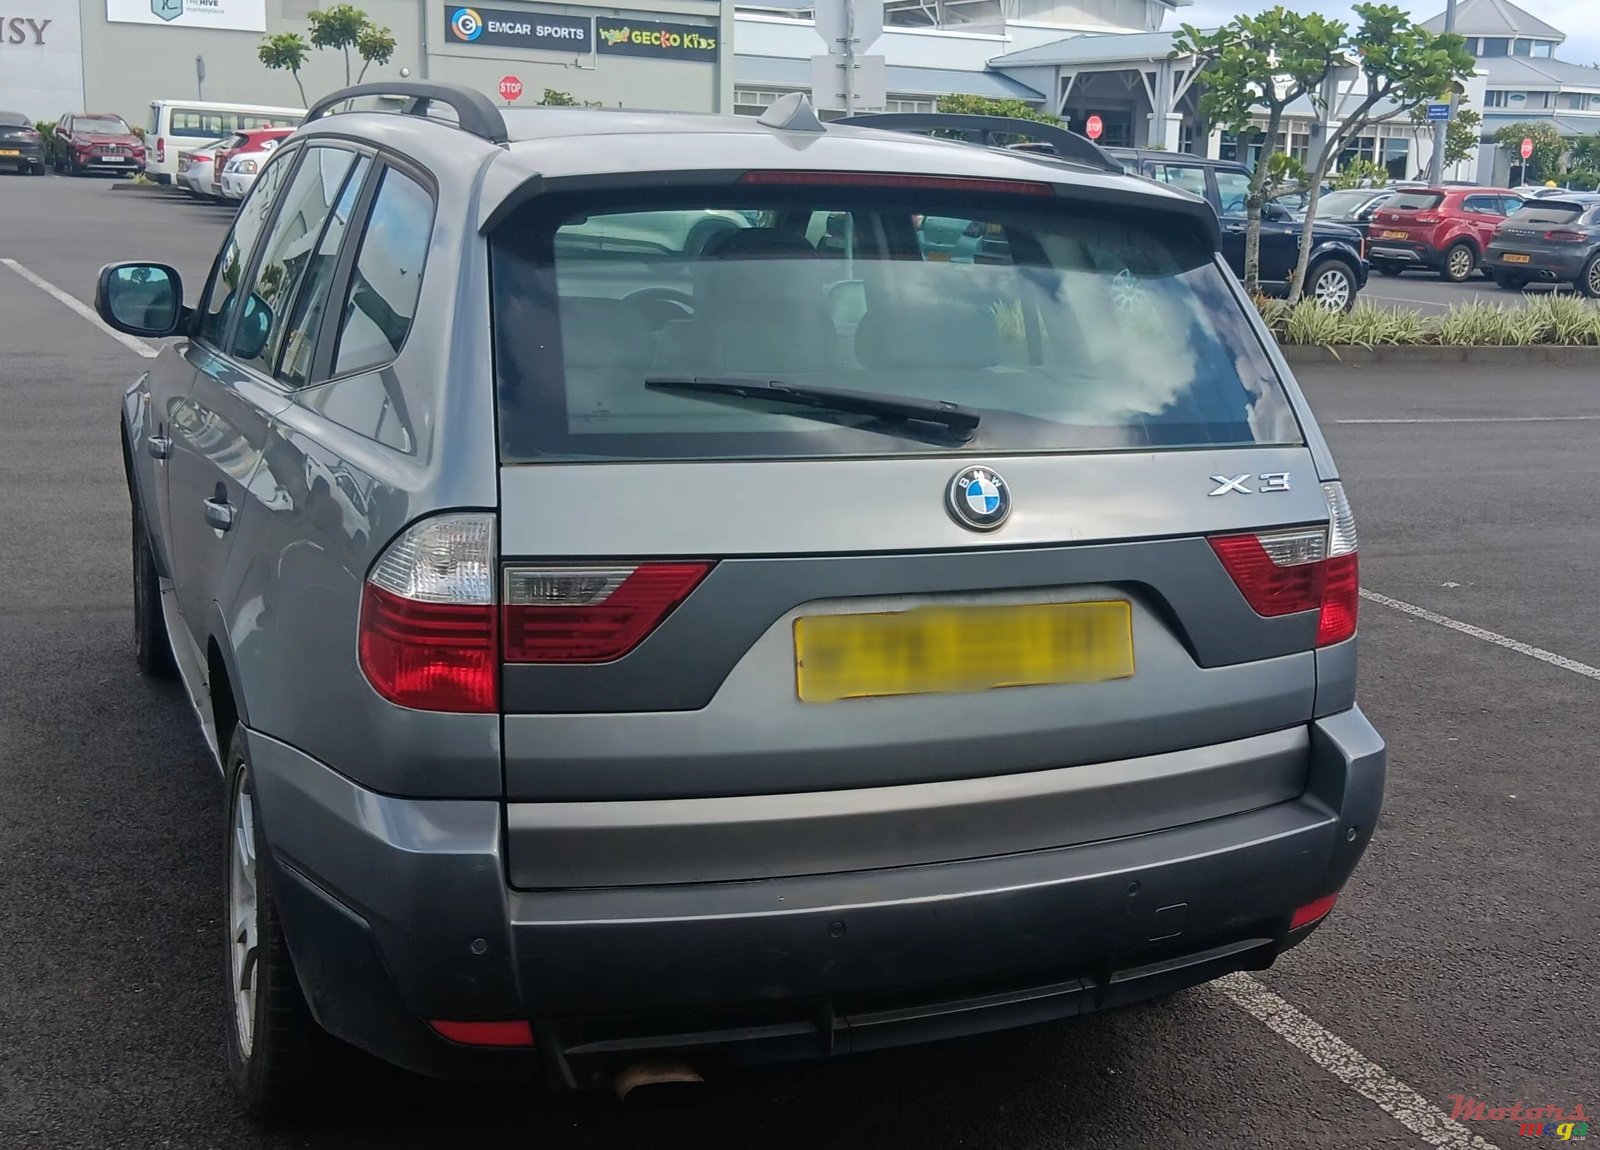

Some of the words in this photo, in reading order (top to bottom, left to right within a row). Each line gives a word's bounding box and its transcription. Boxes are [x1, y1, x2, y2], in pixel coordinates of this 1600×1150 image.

[488, 21, 531, 35] EMCAR
[536, 26, 584, 39] SPORTS
[632, 30, 680, 48] GECKO
[500, 82, 521, 94] STOP
[1087, 122, 1102, 132] STOP
[959, 470, 1002, 488] BMW
[1208, 472, 1290, 496] X3
